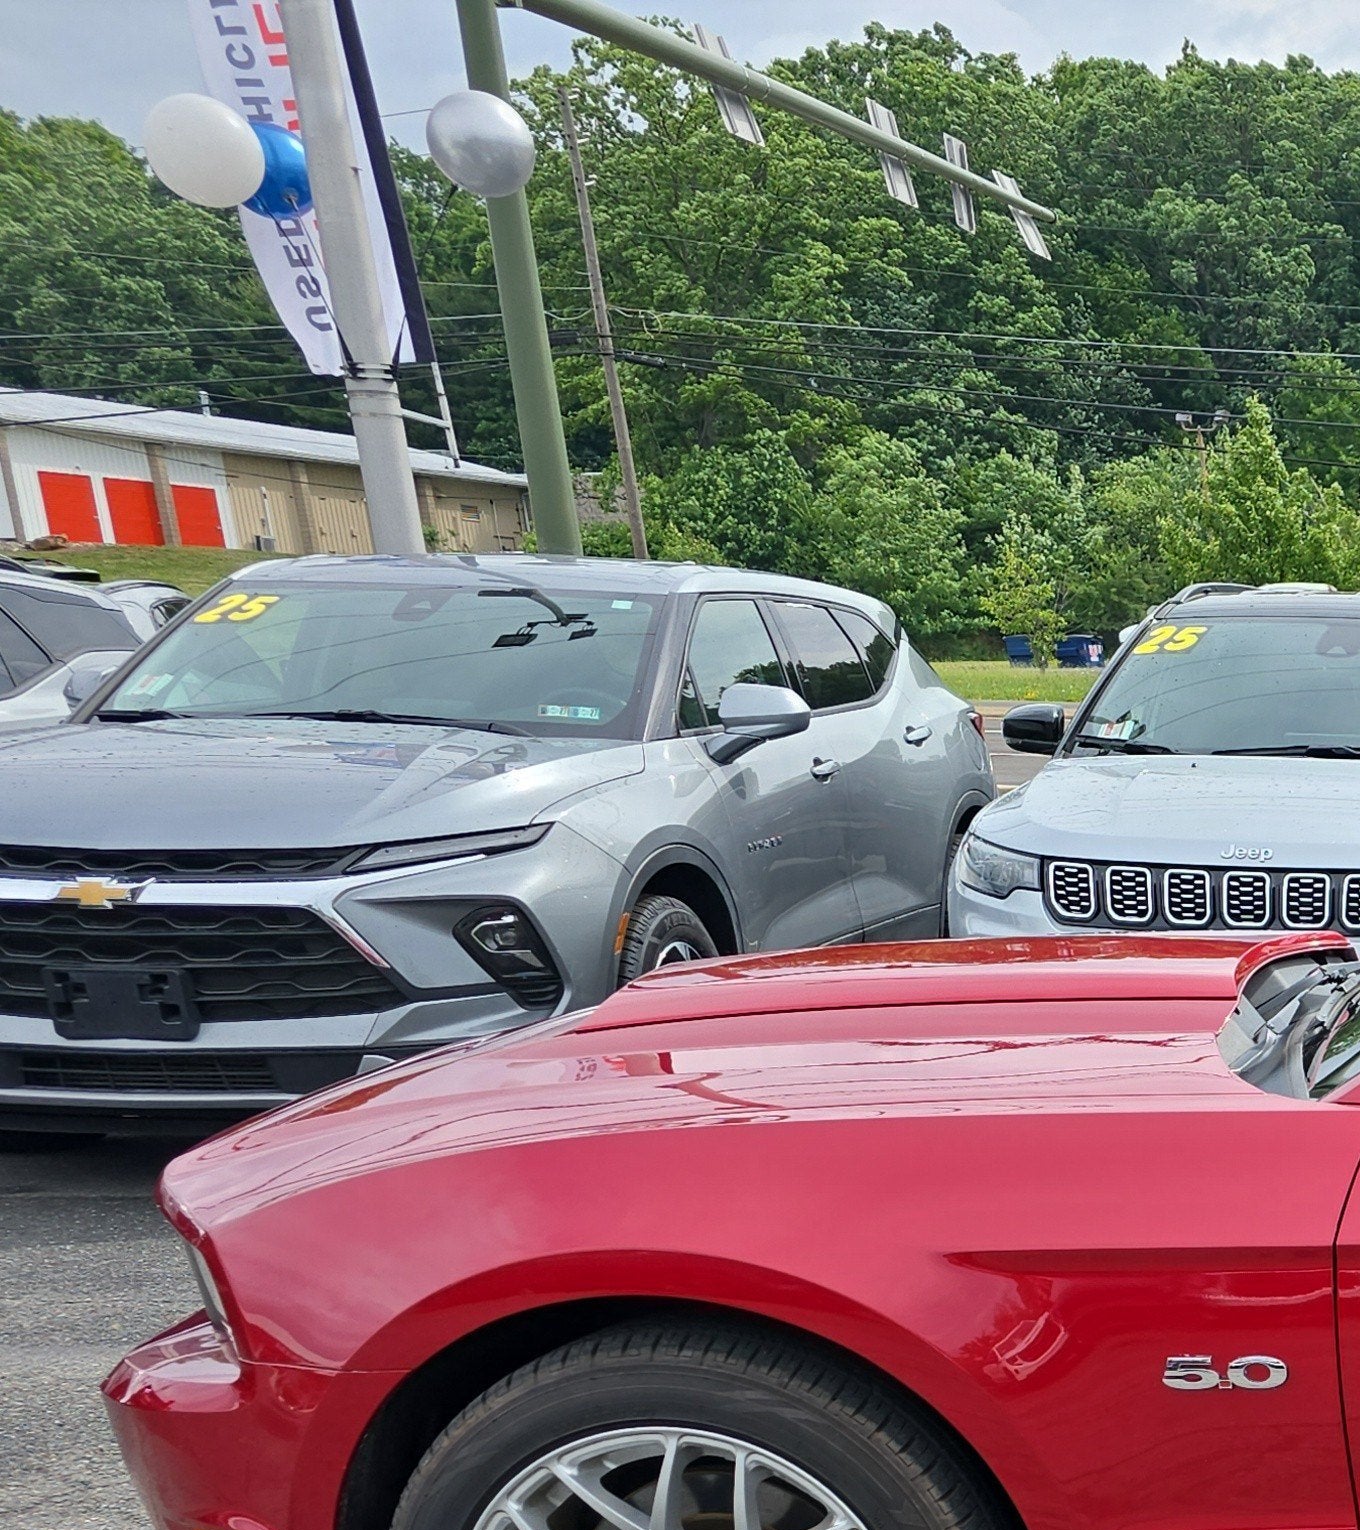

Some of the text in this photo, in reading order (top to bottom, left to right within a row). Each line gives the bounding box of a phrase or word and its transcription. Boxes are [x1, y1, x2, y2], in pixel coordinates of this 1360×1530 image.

[193, 594, 280, 623] 25
[1133, 625, 1208, 655] 25
[1220, 843, 1274, 863] Jeep
[1161, 1354, 1288, 1390] 5.0
